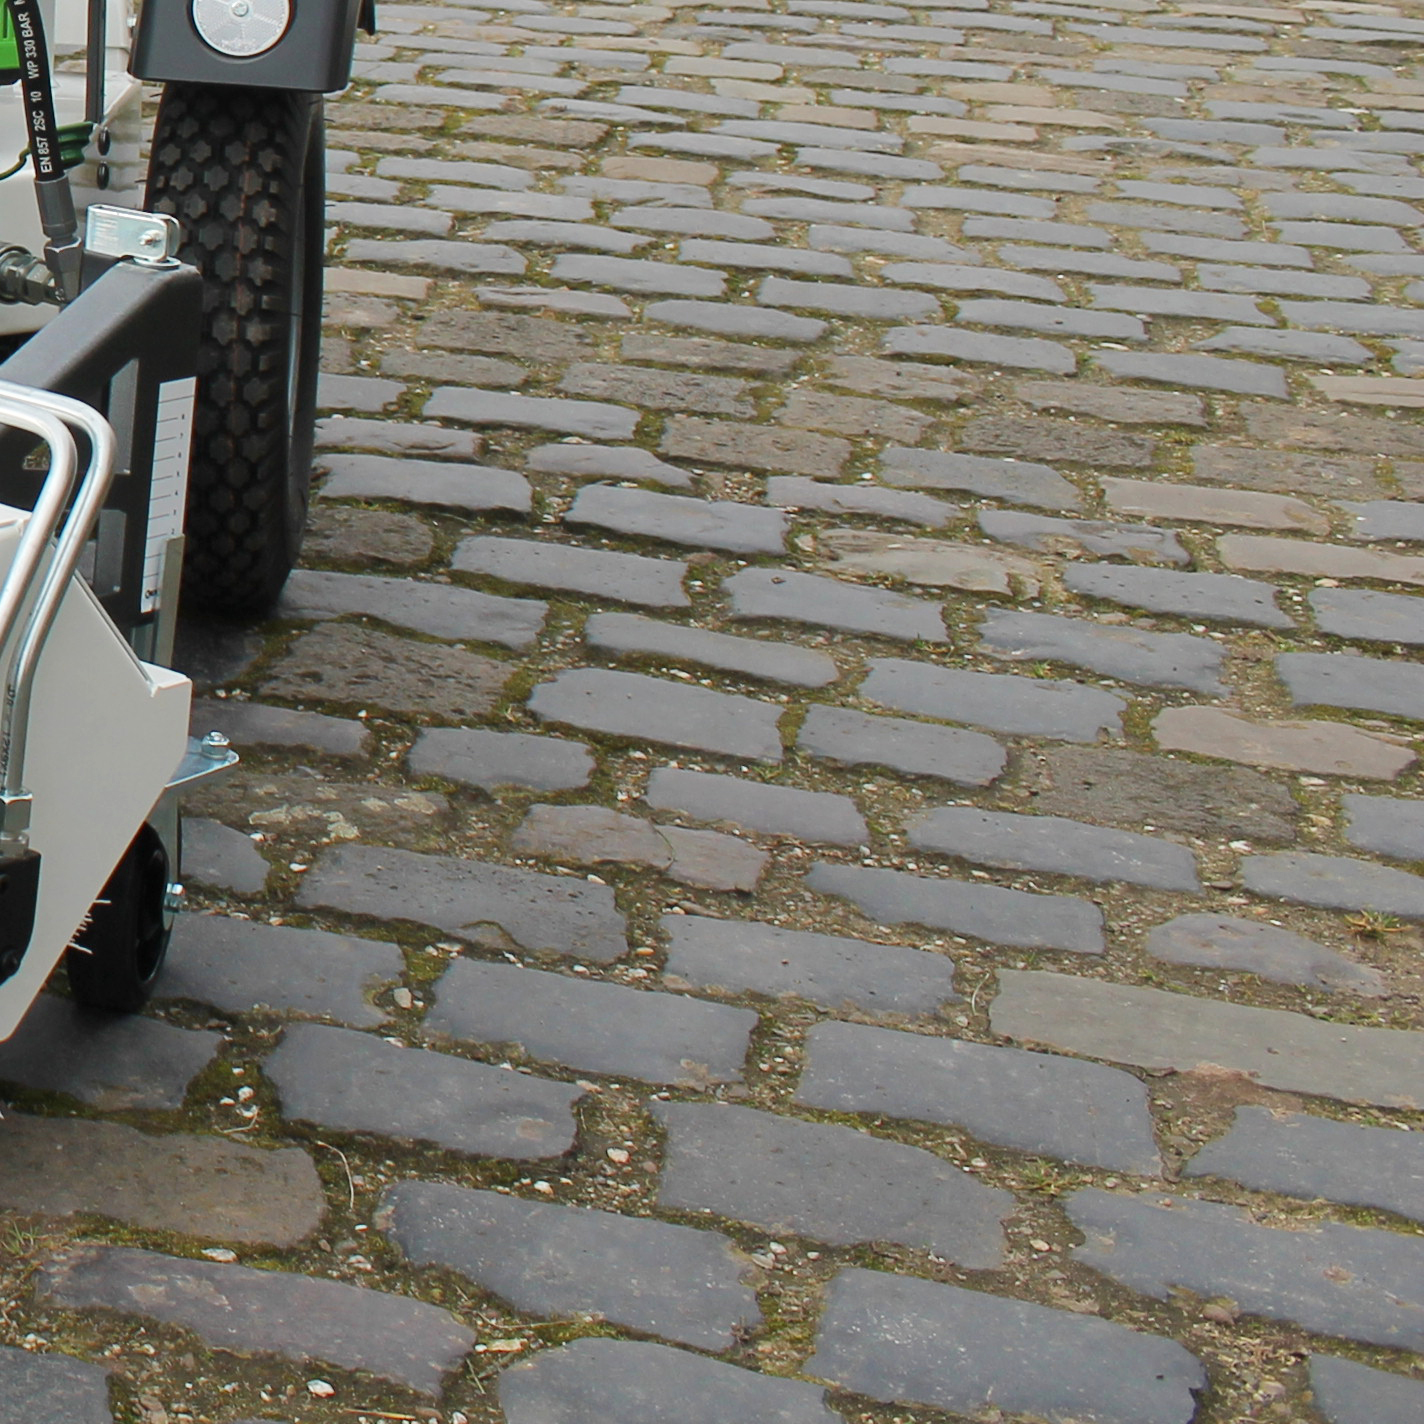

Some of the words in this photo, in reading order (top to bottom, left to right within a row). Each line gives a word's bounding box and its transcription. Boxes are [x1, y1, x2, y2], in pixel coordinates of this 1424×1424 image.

[18, 11, 33, 37] BAR
[25, 39, 37, 60] 330
[26, 61, 40, 80] WP
[30, 91, 42, 102] 10
[32, 109, 46, 132] 2SC
[36, 136, 50, 159] 857
[40, 158, 53, 174] EN
